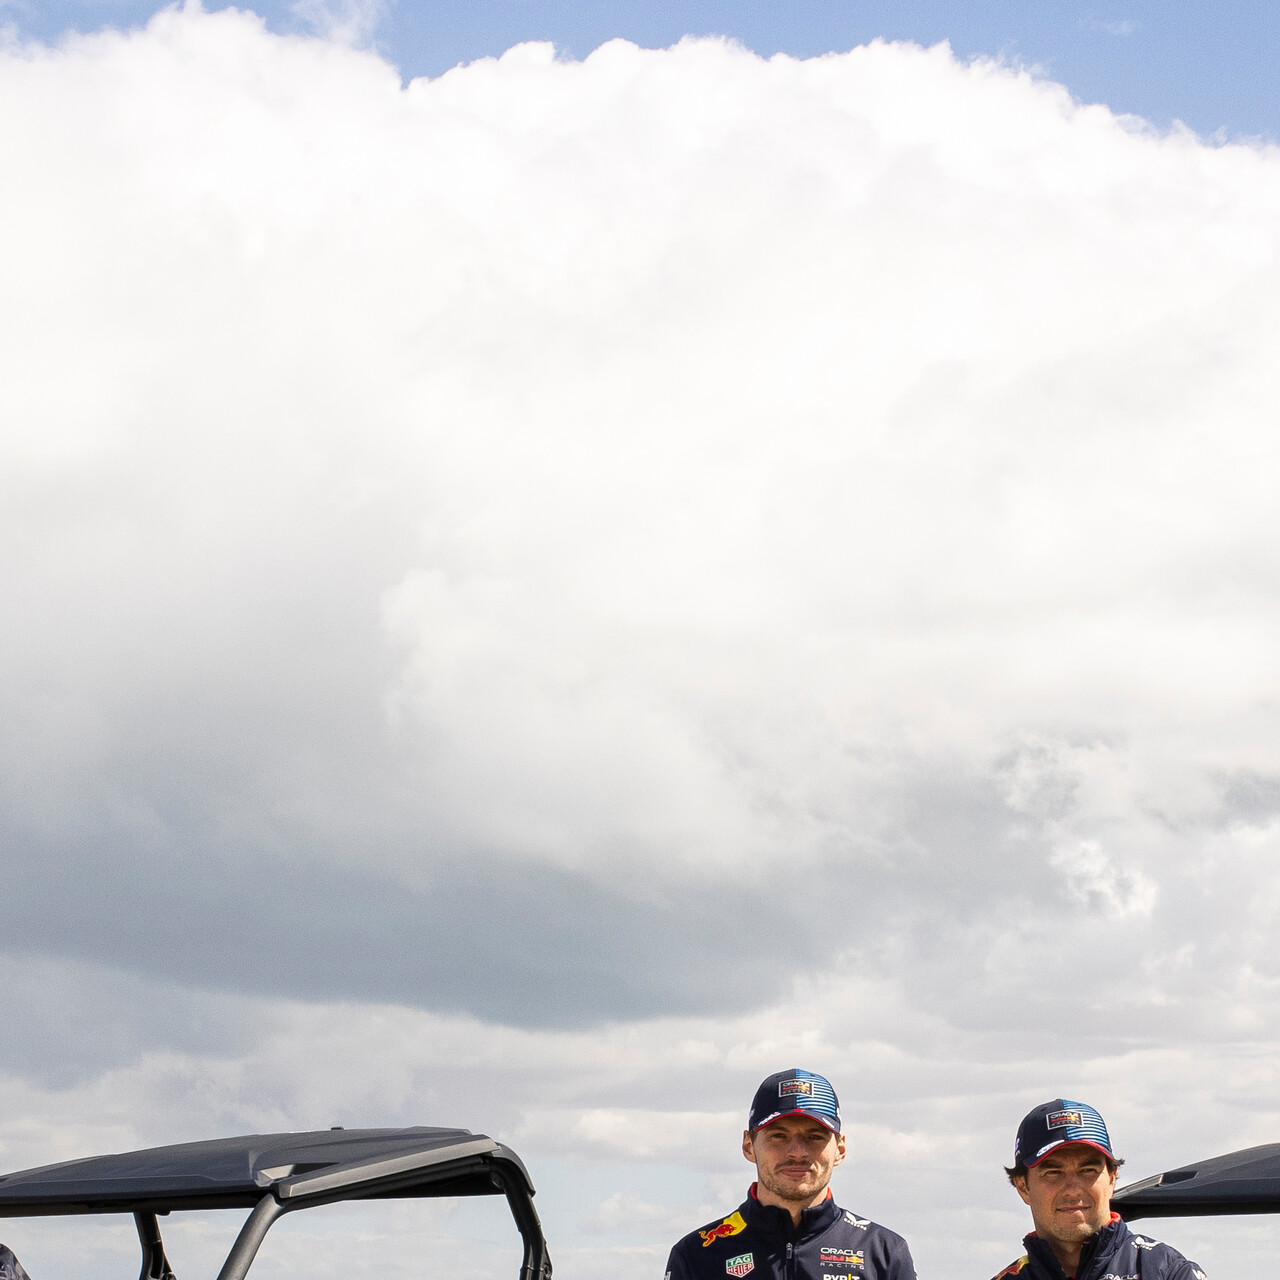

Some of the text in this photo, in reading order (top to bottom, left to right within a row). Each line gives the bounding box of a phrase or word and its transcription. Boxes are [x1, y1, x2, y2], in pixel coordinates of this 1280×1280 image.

[820, 1247, 864, 1257] ORACLE
[730, 1255, 752, 1266] TAG
[728, 1263, 753, 1276] HEUER
[820, 1262, 865, 1270] RACING
[1100, 1273, 1140, 1280] ORACLE
